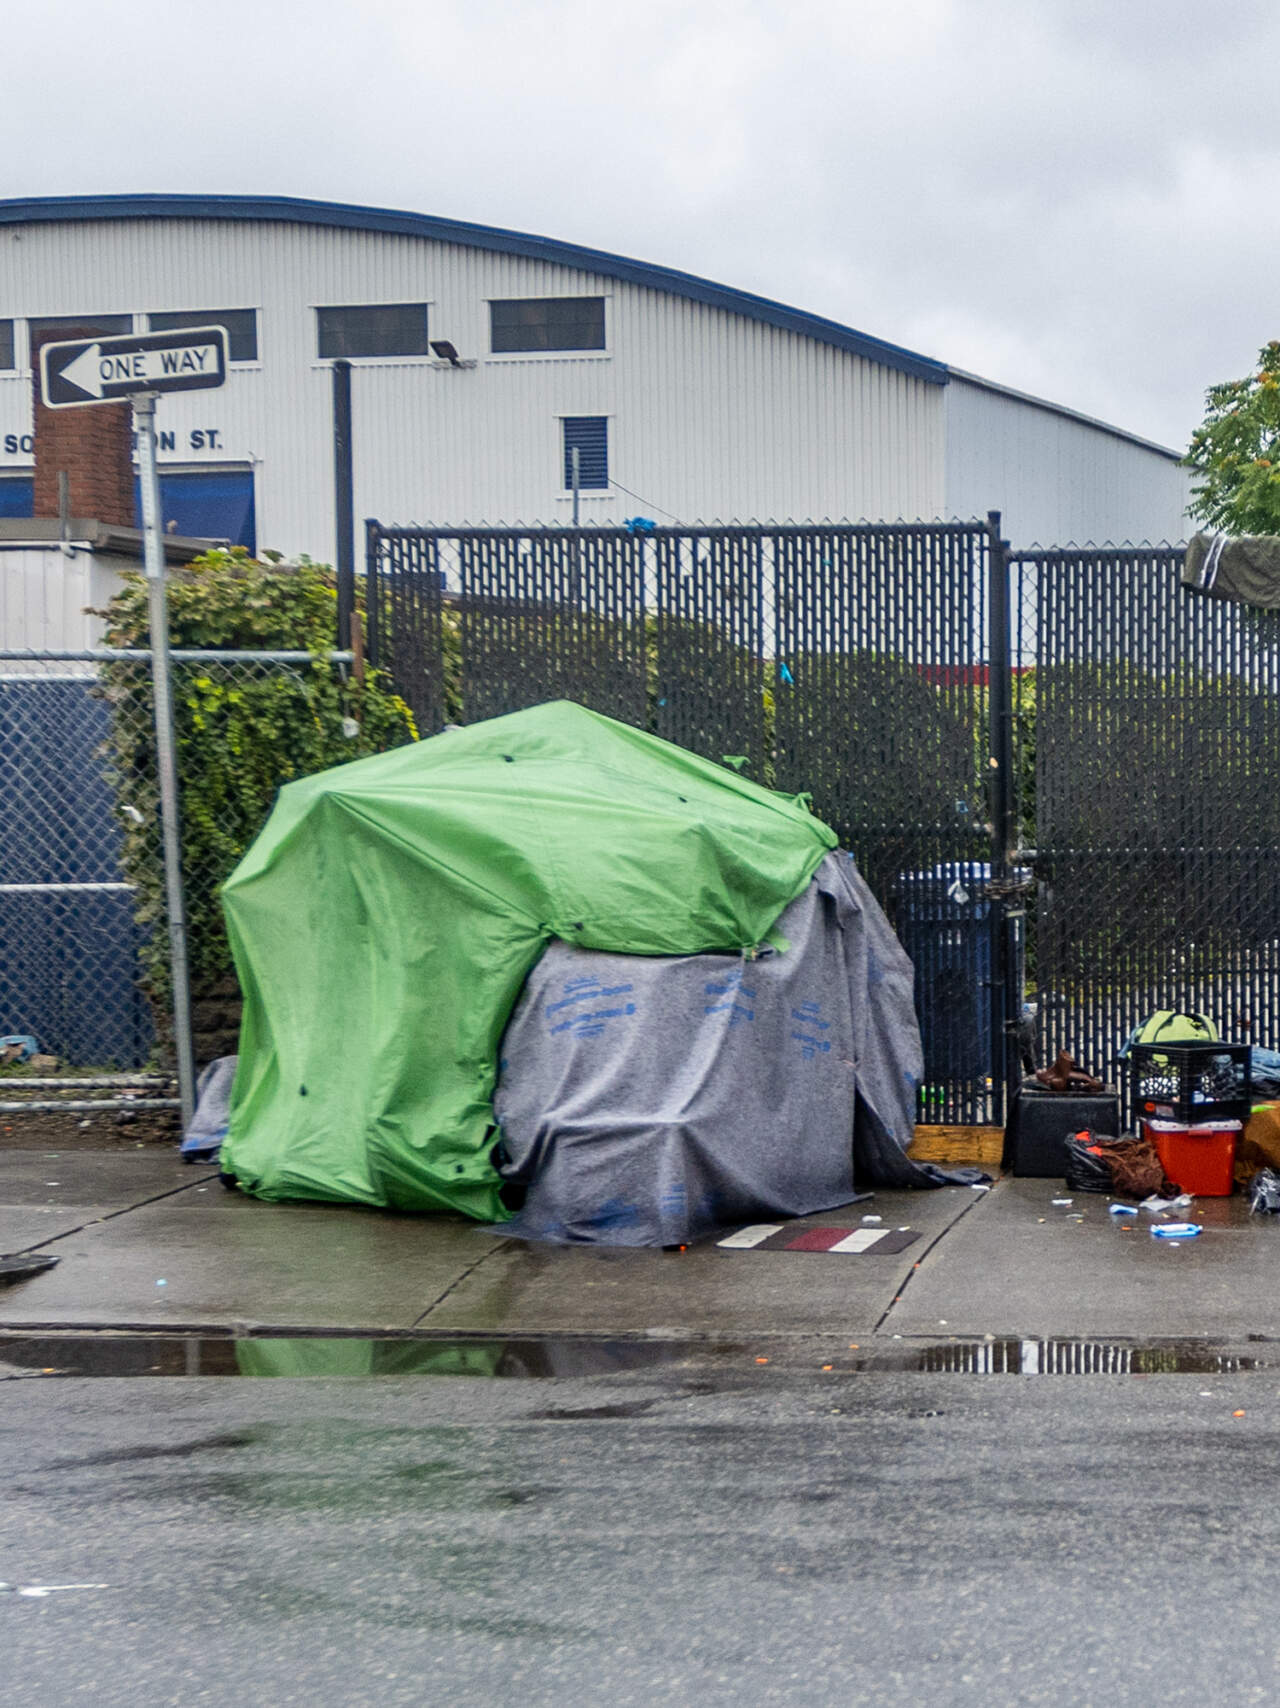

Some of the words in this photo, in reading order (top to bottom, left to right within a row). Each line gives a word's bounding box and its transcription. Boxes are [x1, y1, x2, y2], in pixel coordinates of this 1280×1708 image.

[99, 355, 147, 380] ONE
[161, 347, 208, 374] WAY
[190, 428, 223, 451] ST.
